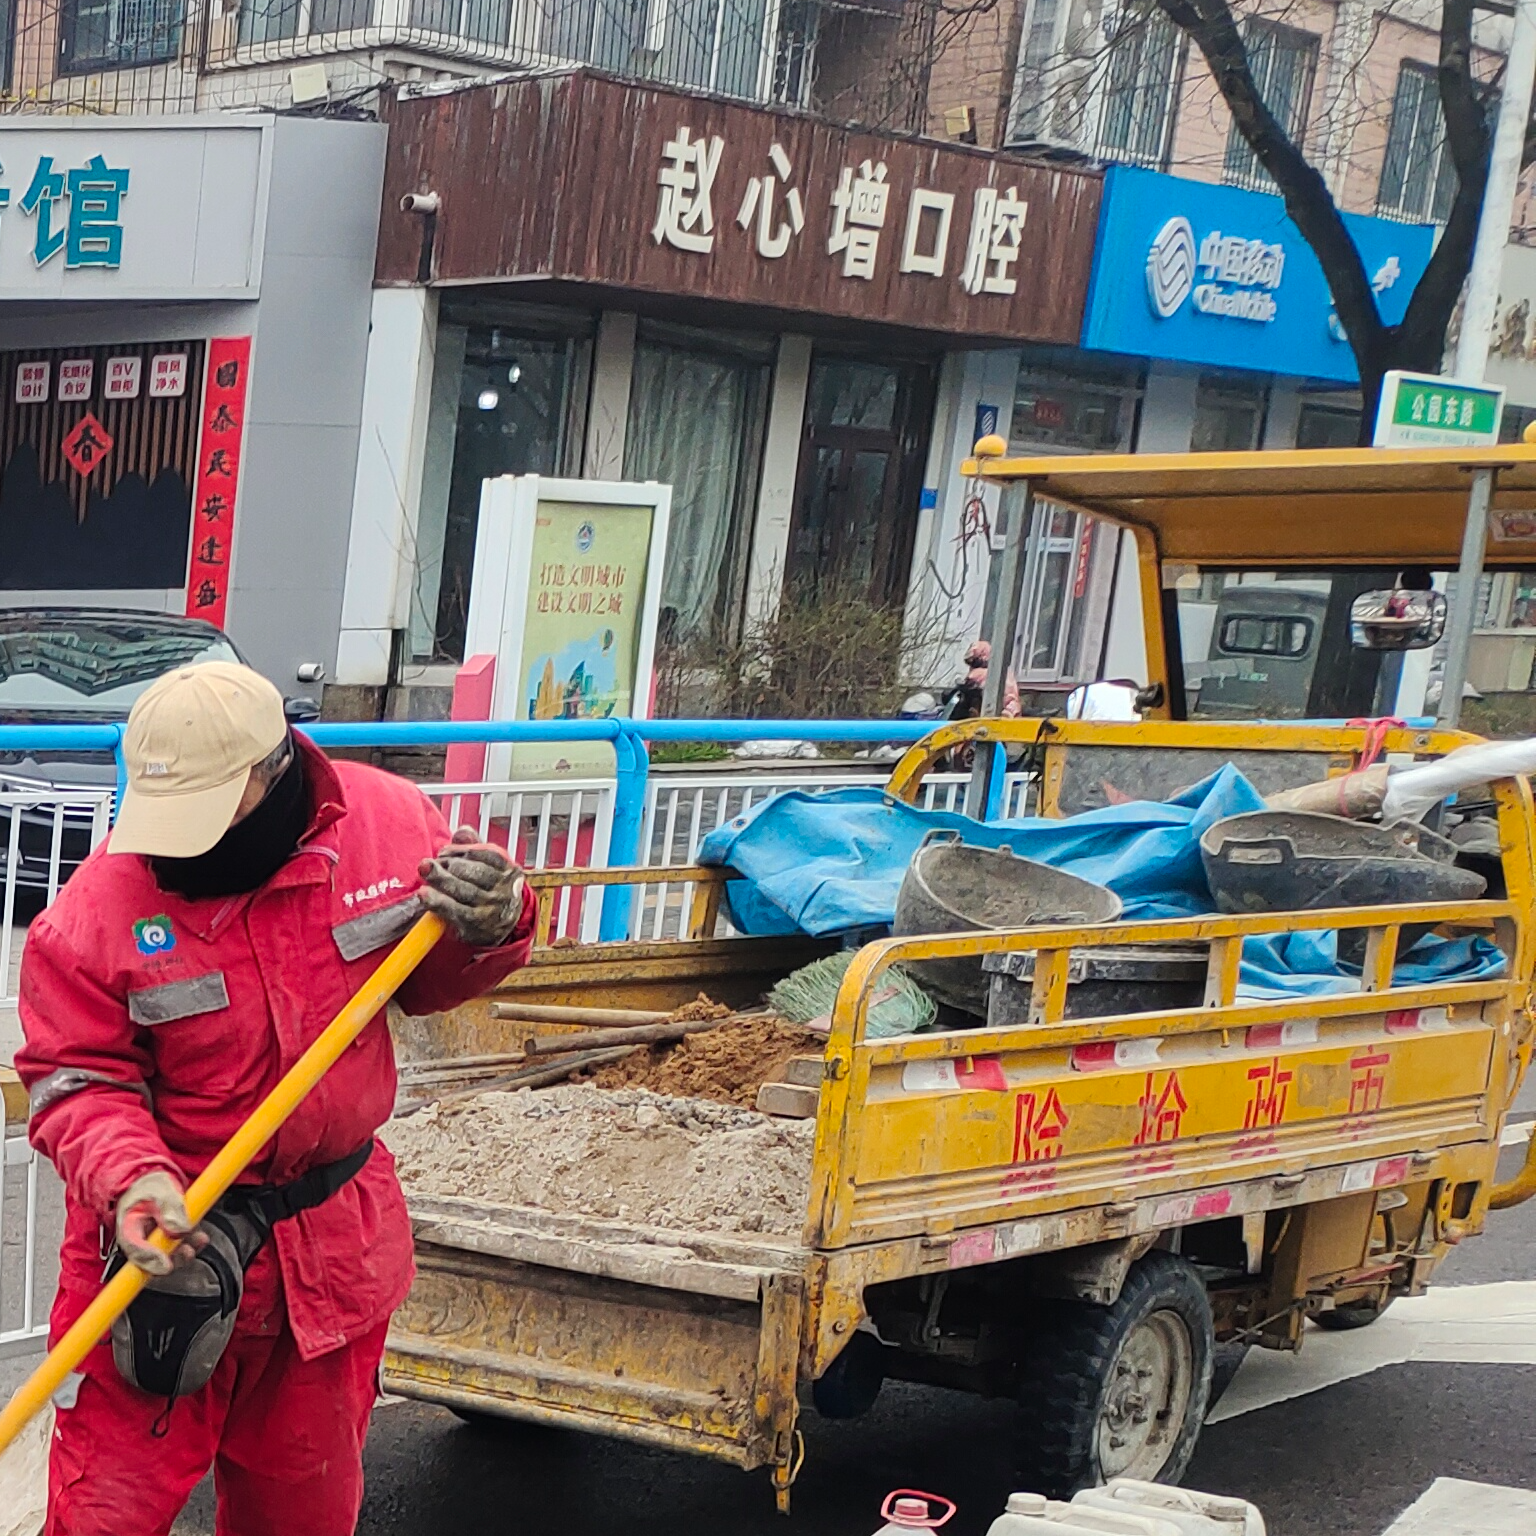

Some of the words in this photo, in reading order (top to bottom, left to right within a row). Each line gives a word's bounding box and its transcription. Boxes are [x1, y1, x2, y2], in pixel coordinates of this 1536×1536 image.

[651, 126, 1029, 298] 赵心增口腔
[1198, 231, 1285, 290] 中国移动
[155, 376, 180, 391] 净水
[1412, 393, 1476, 428] 公园东路
[539, 562, 626, 588] 打造文明城市
[536, 591, 623, 615] 建设文明之城
